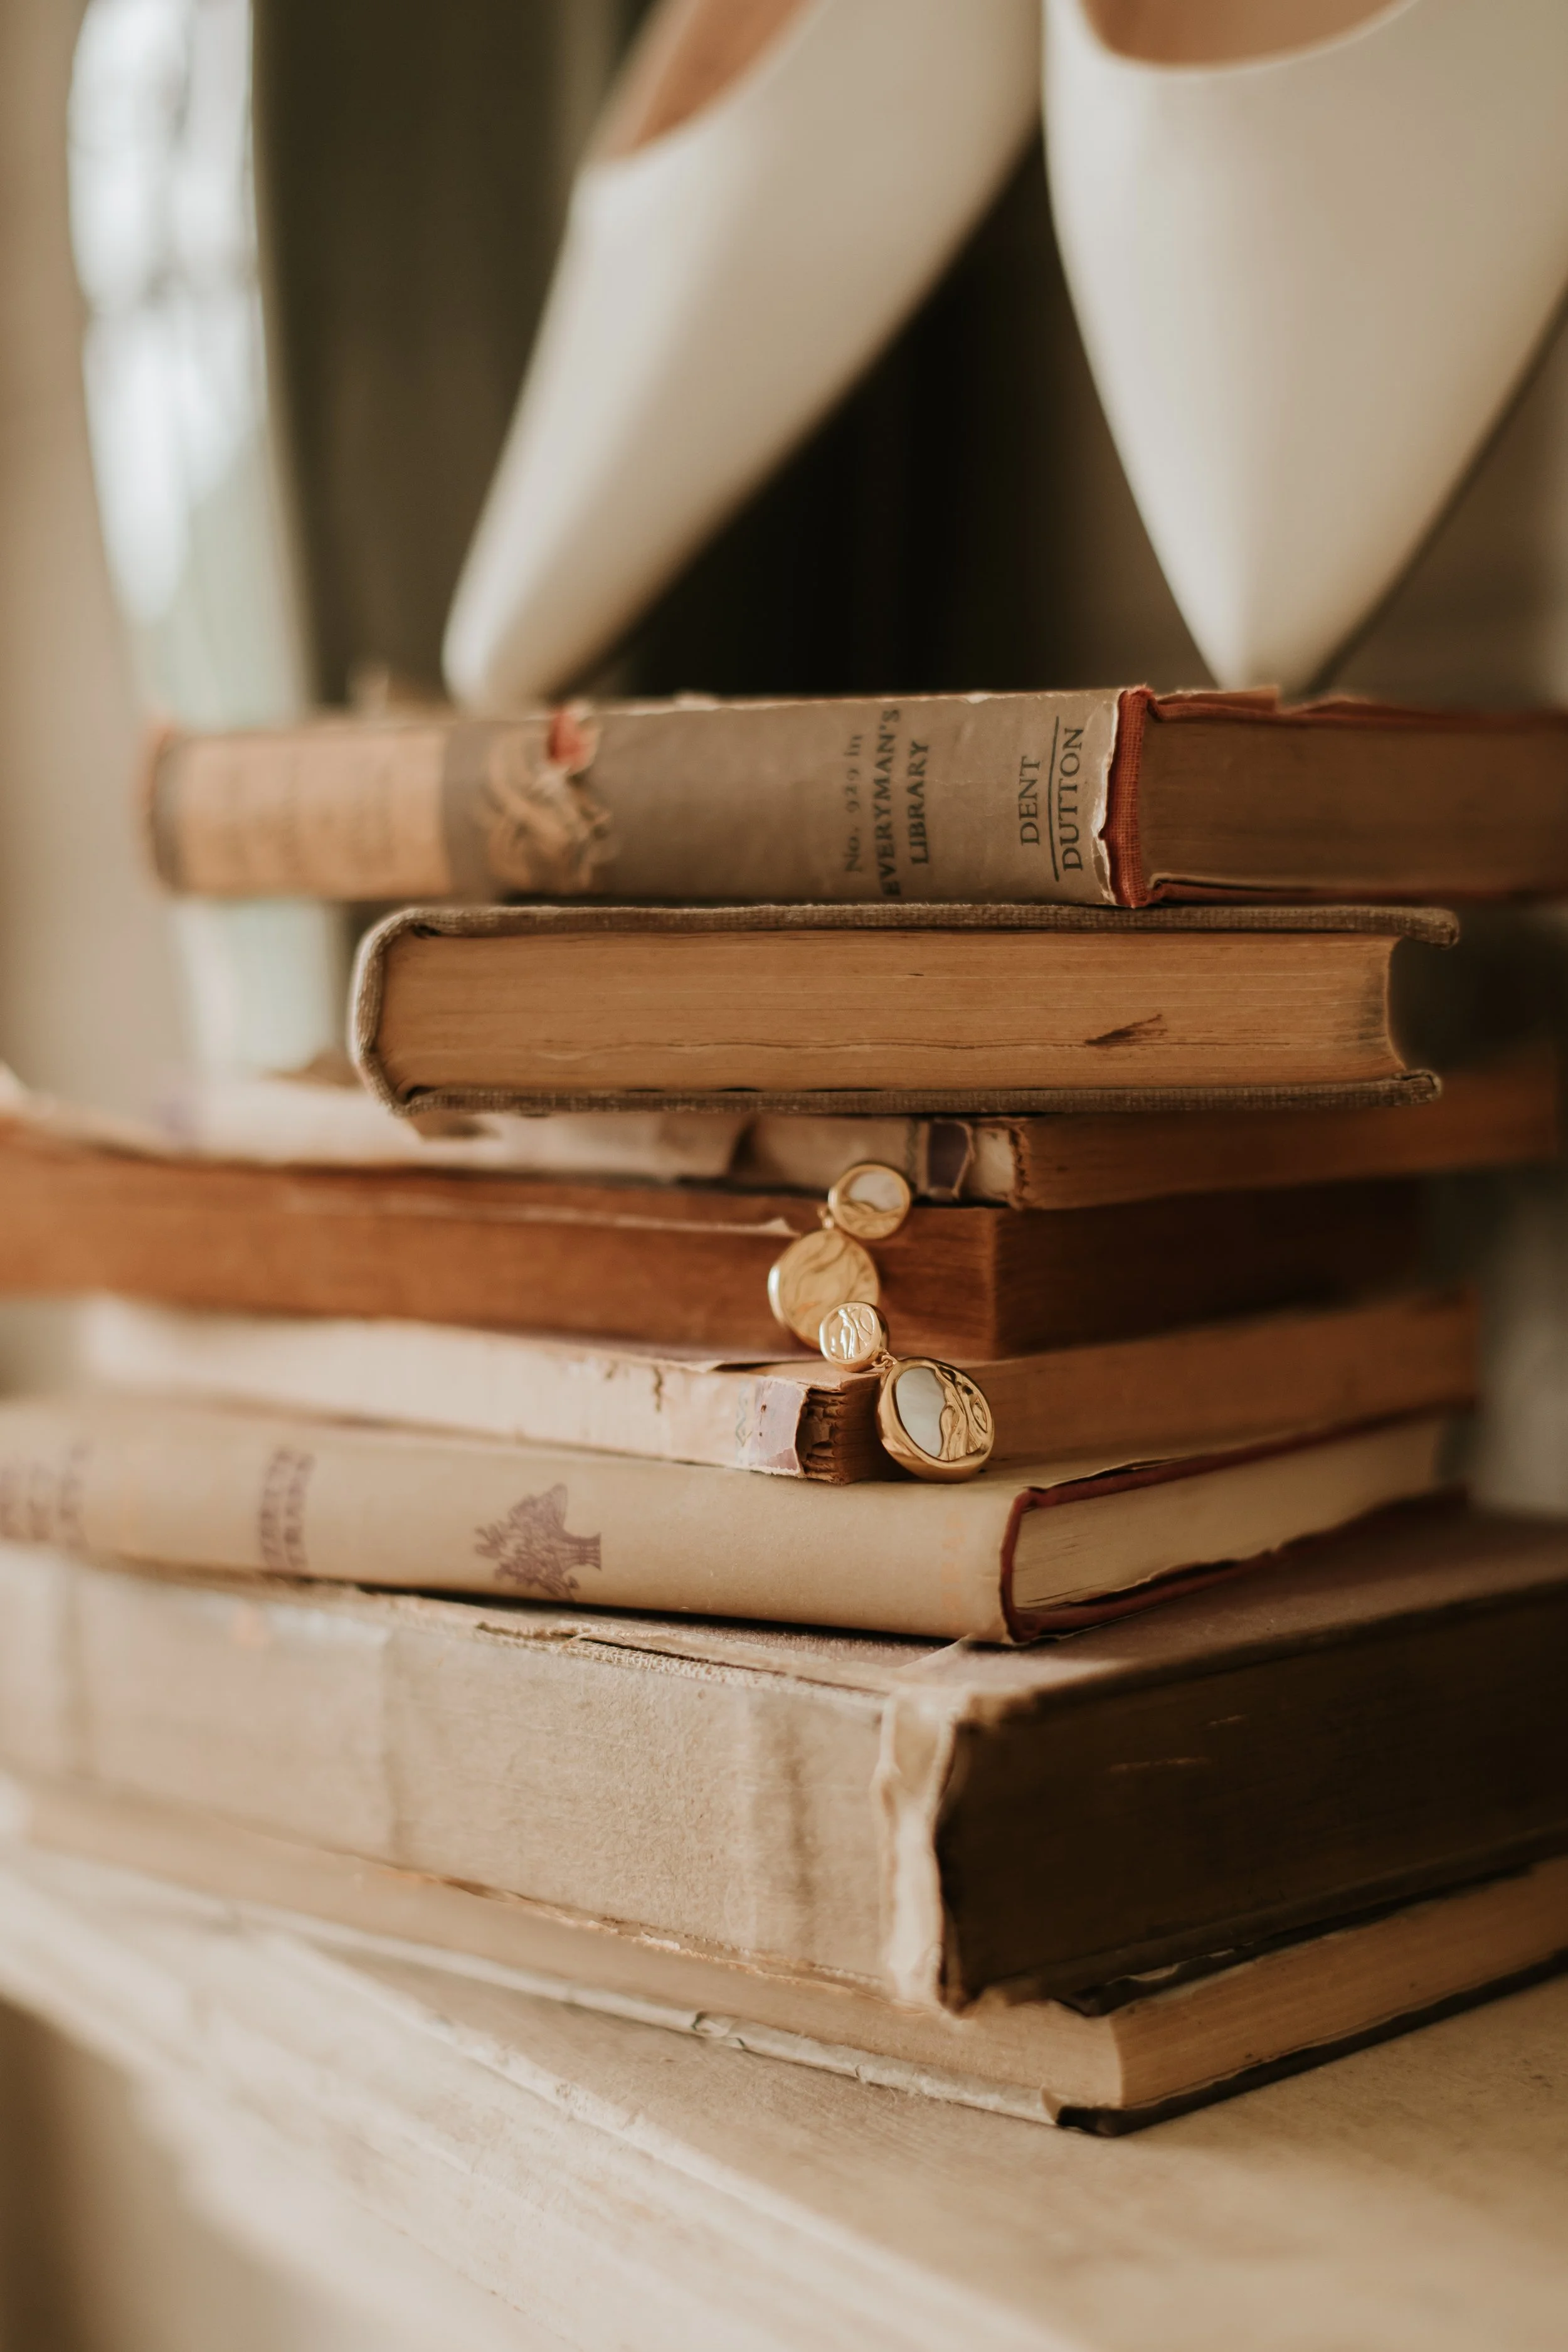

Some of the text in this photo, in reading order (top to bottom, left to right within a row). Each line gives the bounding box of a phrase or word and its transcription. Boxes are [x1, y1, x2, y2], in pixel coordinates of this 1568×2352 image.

[844, 827, 863, 872] No.
[873, 708, 901, 896] EVERYMAN'S
[907, 740, 929, 865] LIBRARY
[1018, 755, 1041, 846] DENT
[1057, 728, 1084, 871] DUTTON
